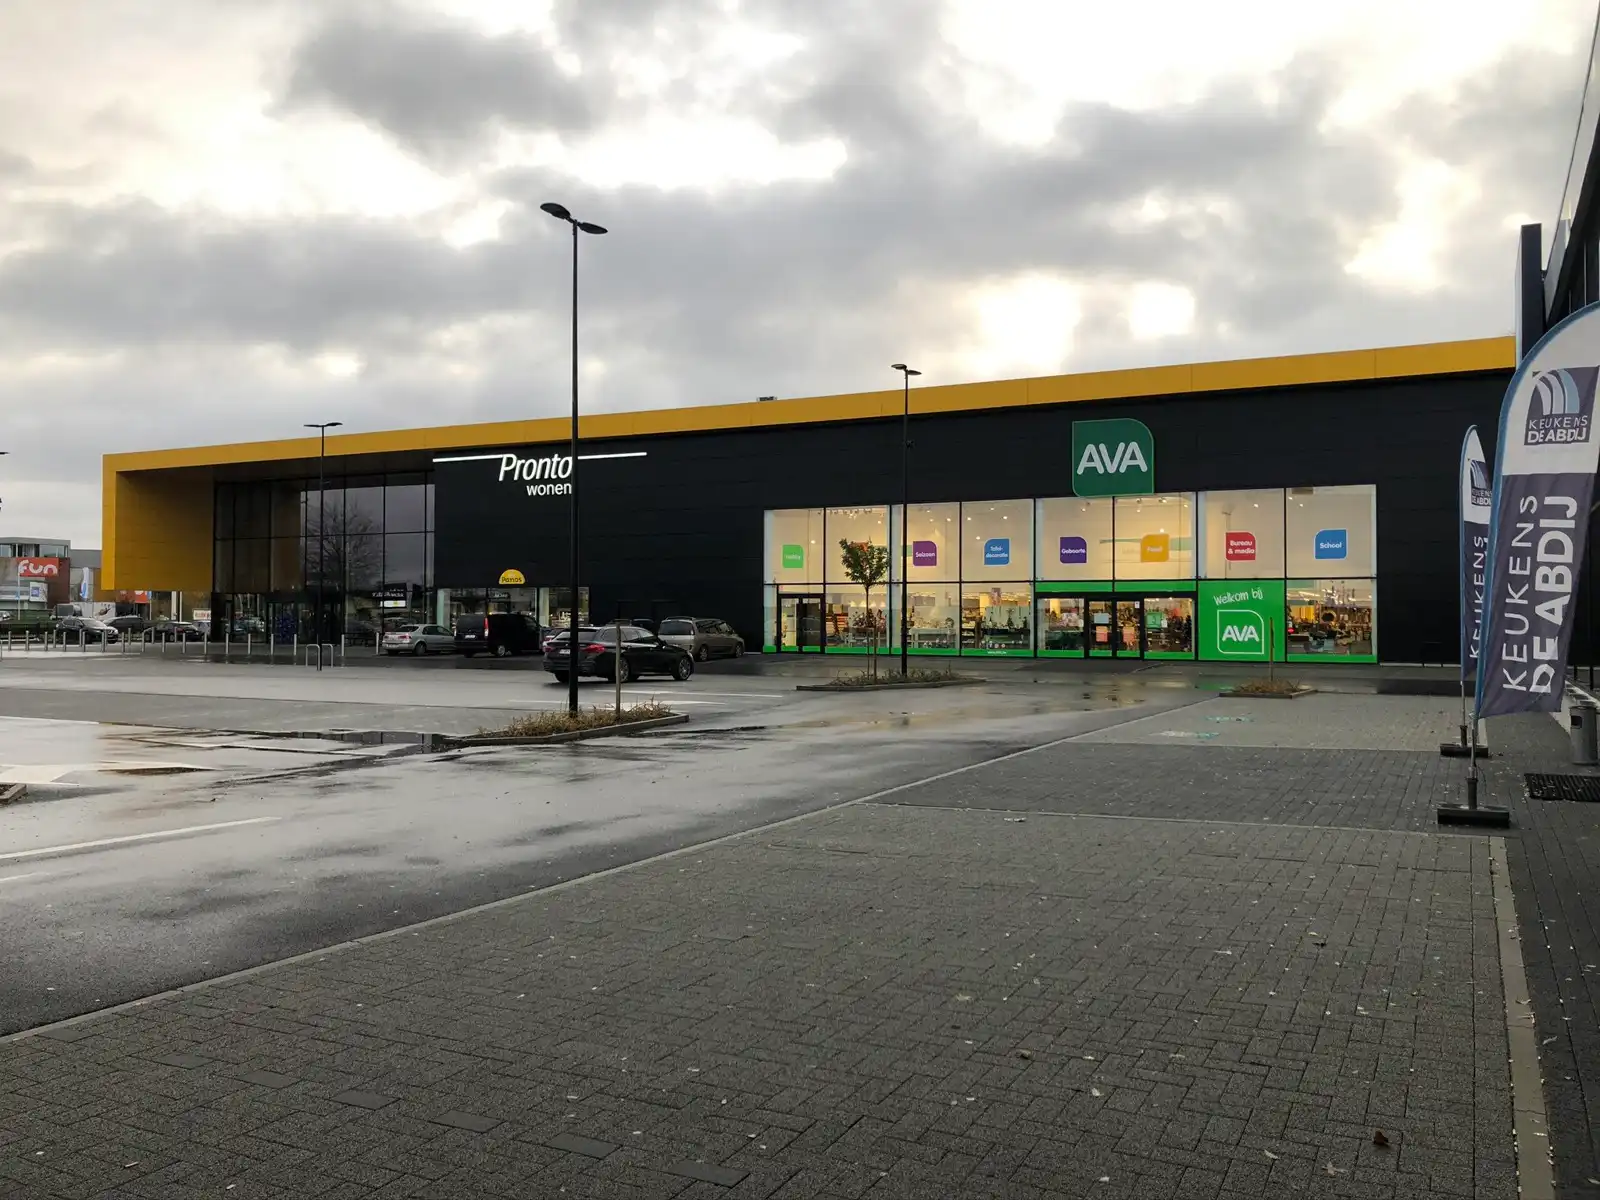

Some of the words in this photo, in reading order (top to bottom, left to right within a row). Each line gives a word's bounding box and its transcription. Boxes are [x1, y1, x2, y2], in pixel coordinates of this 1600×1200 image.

[1529, 415, 1588, 430] KEUKENS
[1077, 441, 1148, 475] AVA
[499, 454, 573, 481] Pronto
[526, 483, 572, 496] wonen
[1319, 542, 1342, 550] School
[18, 559, 58, 575] fun
[1535, 496, 1578, 626] ABDIJ
[1213, 592, 1248, 605] Welkom
[1251, 587, 1263, 600] bij
[1501, 496, 1538, 692] KEUKENS
[1222, 625, 1260, 642] AVA
[1529, 636, 1559, 693] DE
